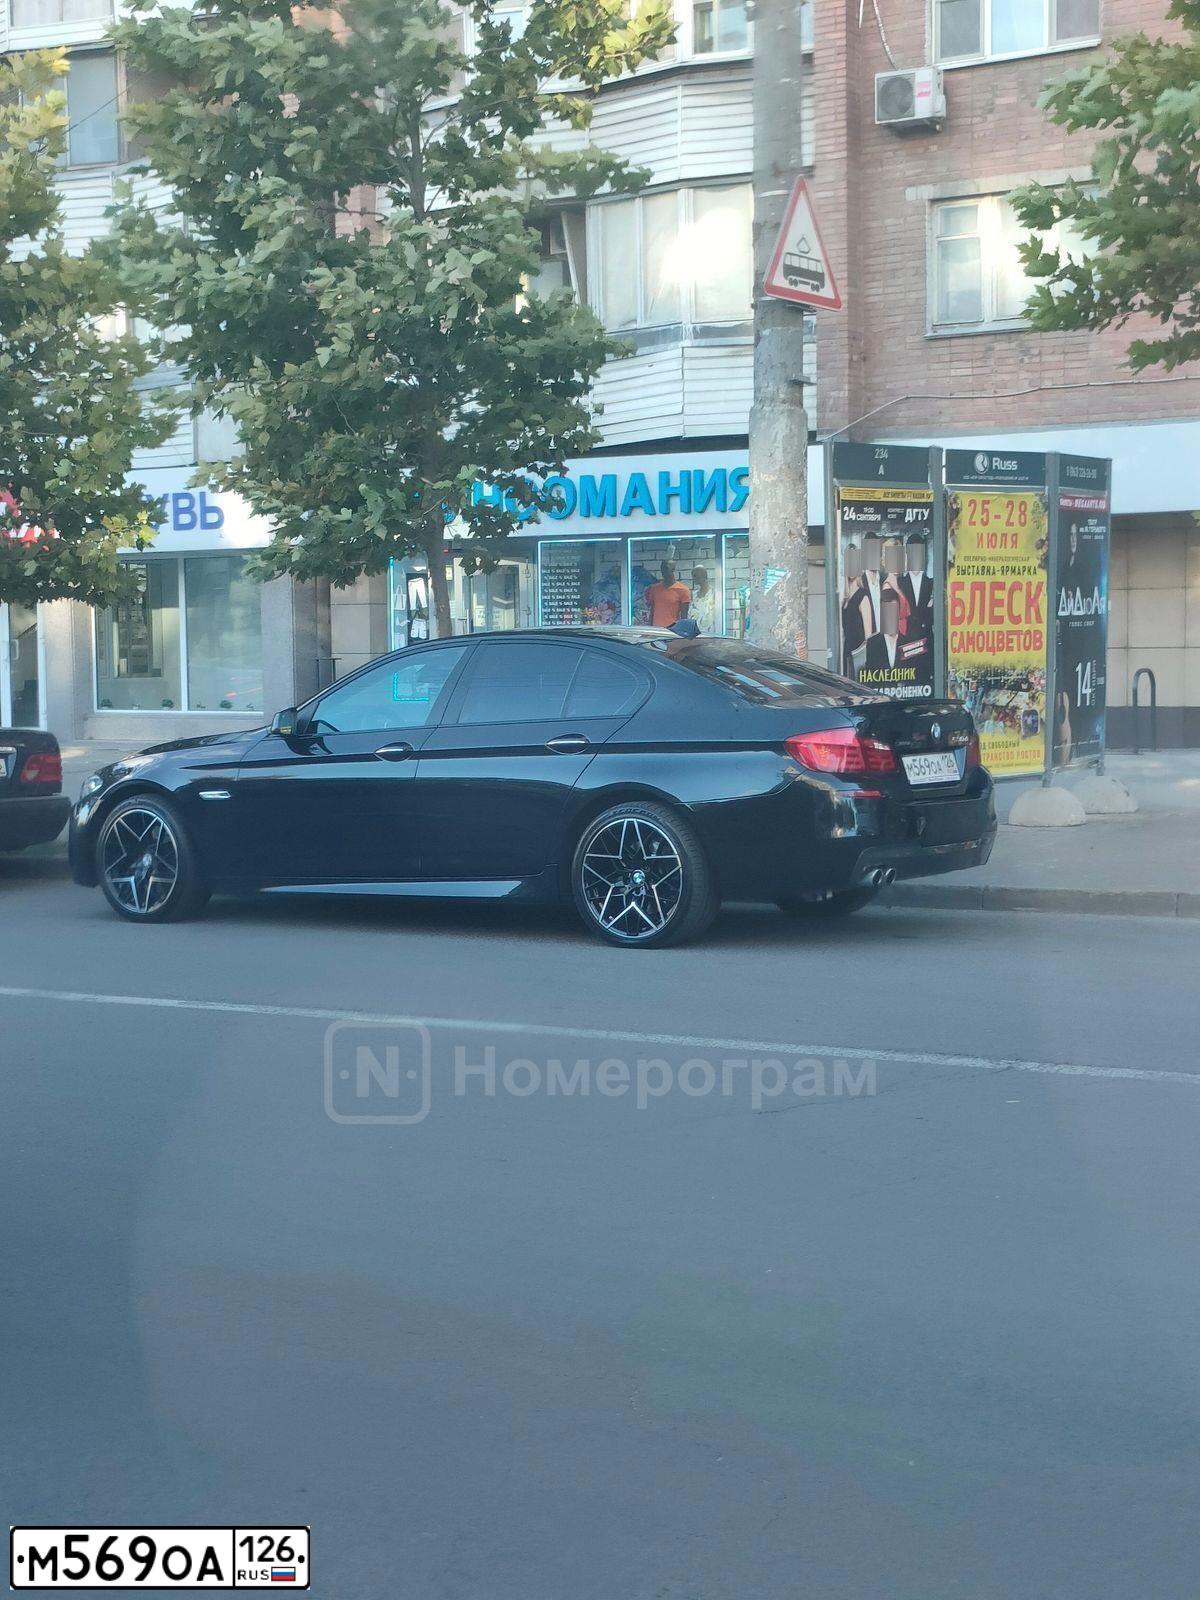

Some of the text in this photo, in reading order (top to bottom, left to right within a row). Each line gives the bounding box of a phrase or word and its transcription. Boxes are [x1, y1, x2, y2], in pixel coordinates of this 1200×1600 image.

[874, 449, 889, 459] 234
[992, 457, 1018, 471] Russ
[843, 506, 856, 521] 24
[904, 508, 930, 523] ДГТУ
[976, 533, 1019, 549] ИЮЛЯ
[956, 565, 1037, 577] ВЫСТАВКА-ЯРМАРКА
[950, 581, 1044, 626] БЛЕСК
[950, 629, 1043, 656] САМОЦВЕТОВ
[859, 667, 916, 683] НАСЛЕДНИК
[1076, 662, 1092, 707] 14
